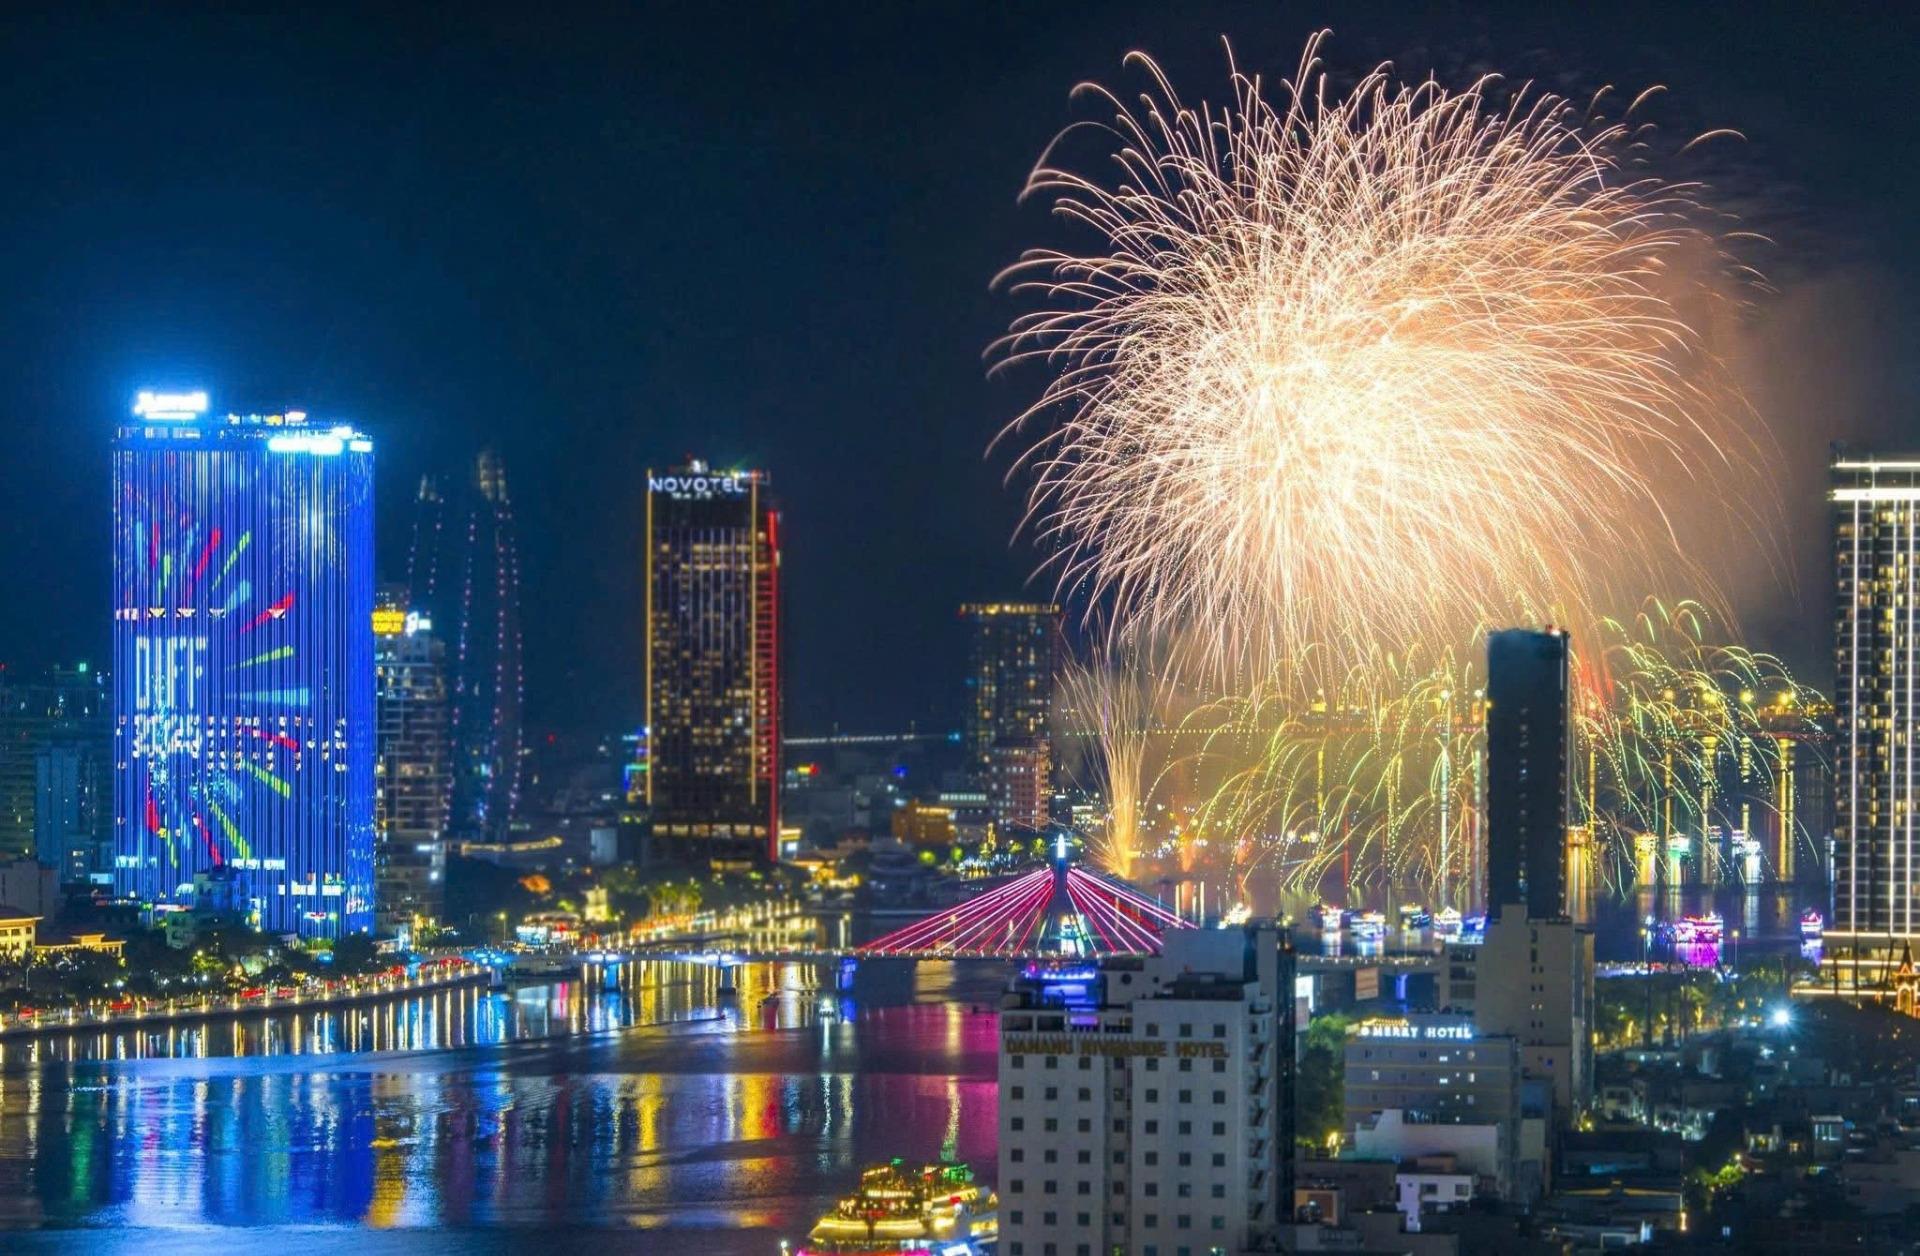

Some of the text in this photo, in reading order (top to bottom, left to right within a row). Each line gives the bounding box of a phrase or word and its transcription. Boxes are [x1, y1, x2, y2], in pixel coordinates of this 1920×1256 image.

[649, 477, 744, 492] NOVOTEL
[136, 636, 207, 709] DIFF
[1427, 1027, 1472, 1039] HOTEL
[1176, 1041, 1230, 1058] HOTEL
